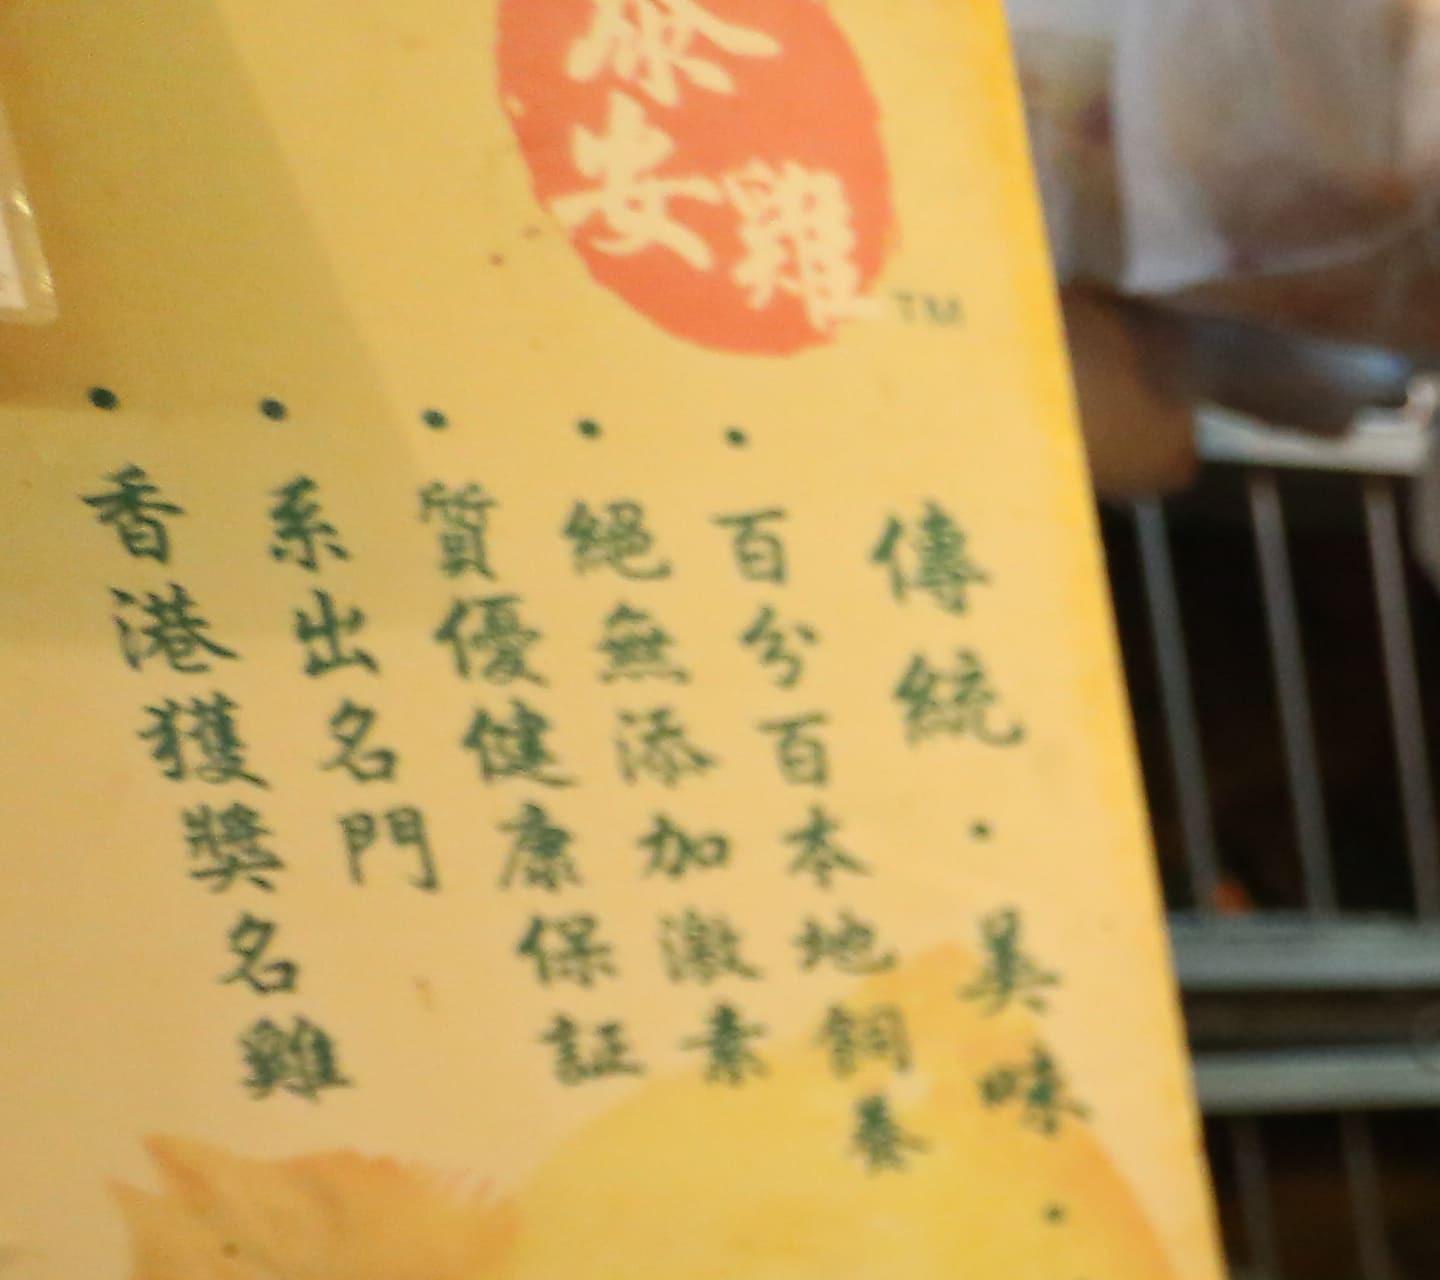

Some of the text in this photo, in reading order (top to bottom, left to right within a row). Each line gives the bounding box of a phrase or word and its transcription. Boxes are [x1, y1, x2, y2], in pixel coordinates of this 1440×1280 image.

[268, 475, 440, 892] 系出名門
[417, 481, 648, 1086] 質優健康保証
[561, 498, 770, 1088] 絕無添加激素
[710, 508, 934, 1173] 百分百本地飼養
